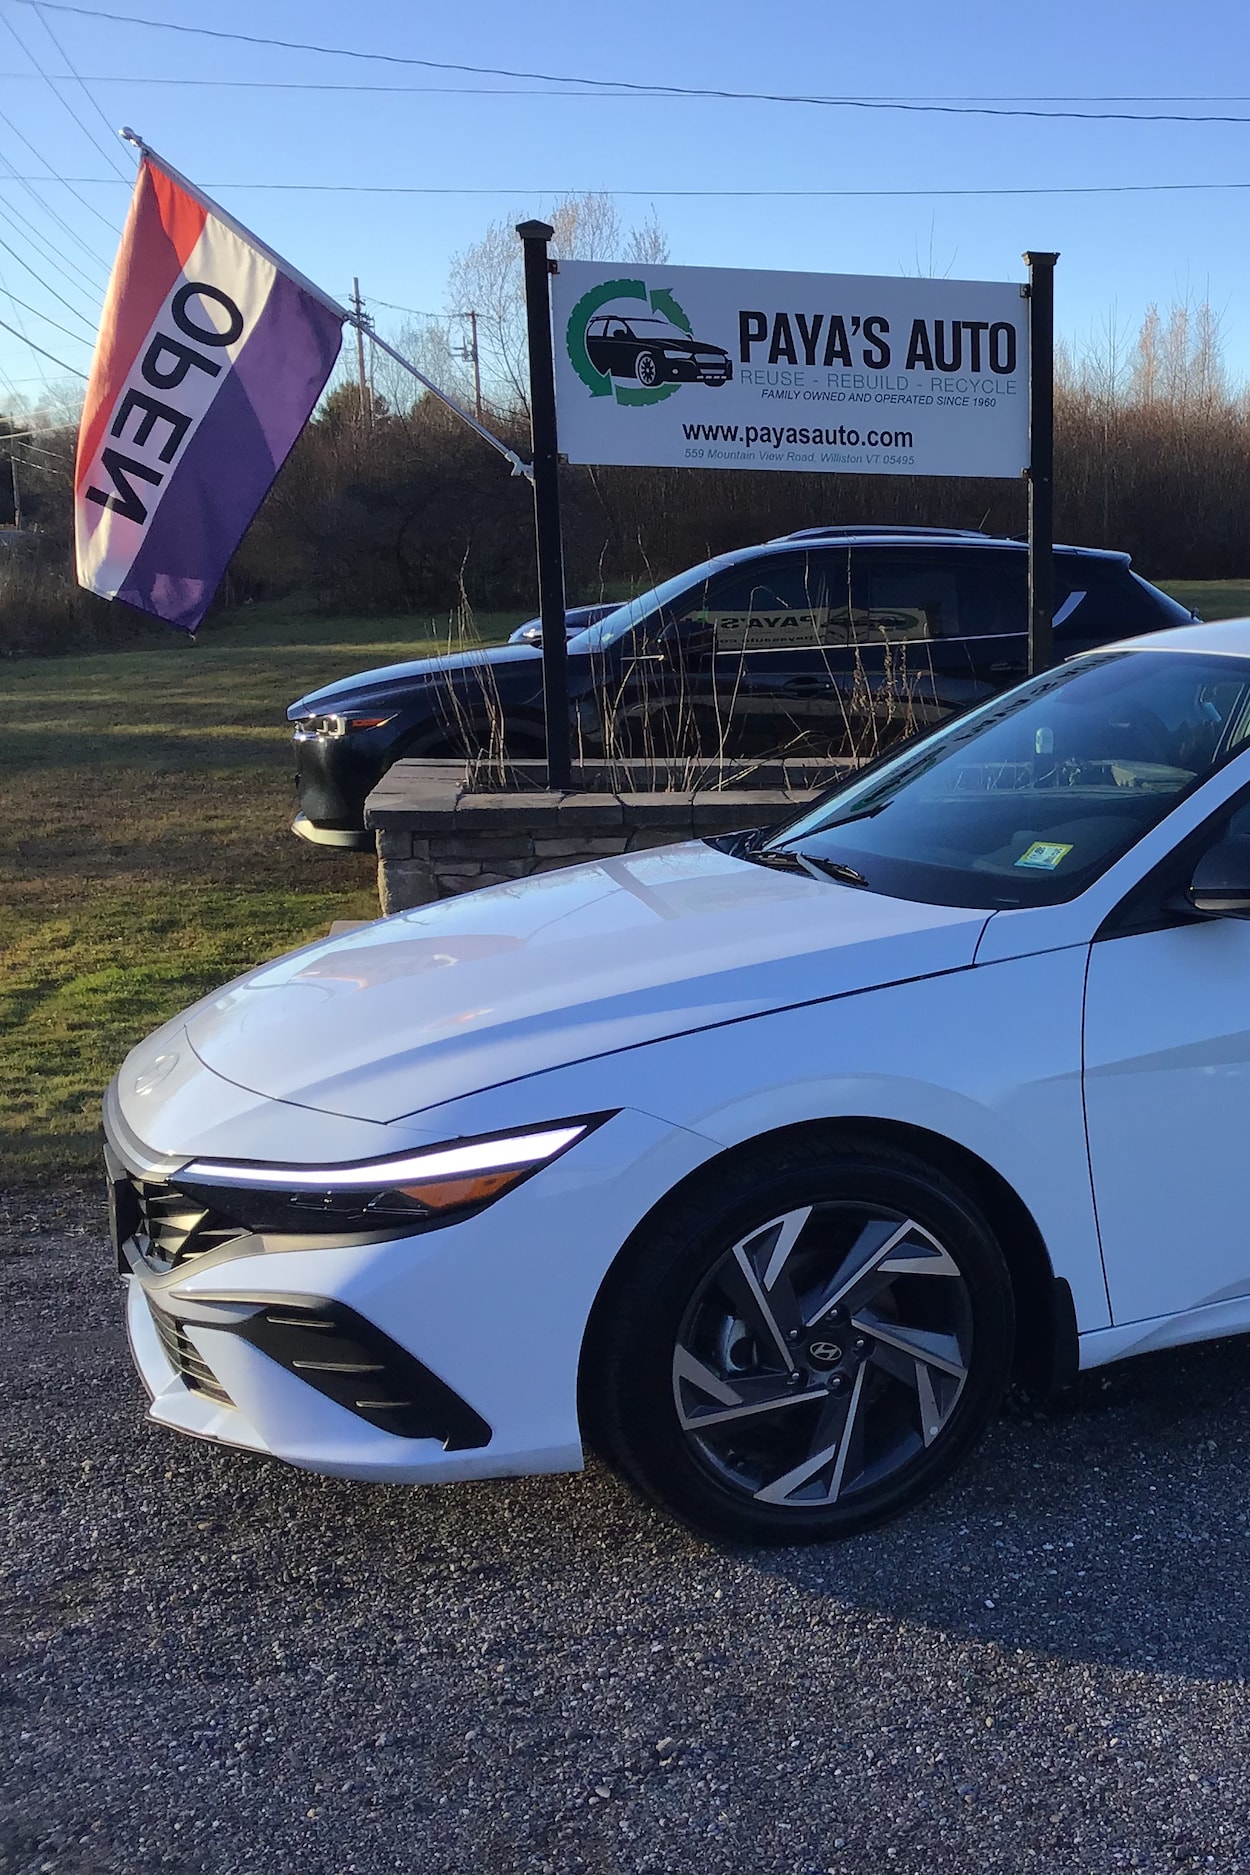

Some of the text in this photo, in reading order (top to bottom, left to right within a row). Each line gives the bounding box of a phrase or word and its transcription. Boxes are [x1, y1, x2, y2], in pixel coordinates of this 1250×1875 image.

[739, 311, 1017, 374] PAYA'S AUTO
[740, 369, 805, 386] REUSE
[827, 373, 909, 391] REBUILD
[931, 377, 1017, 395] RECYCLE
[761, 389, 997, 407] FAMILY OWNED AND OPERATED SINCE 1960
[682, 423, 913, 449] www.payasauto.com
[684, 448, 704, 459] 559
[707, 449, 756, 460] Mountain
[760, 451, 784, 461] View
[821, 453, 862, 463] Williston
[866, 454, 881, 464] VT
[883, 455, 915, 465] 05495
